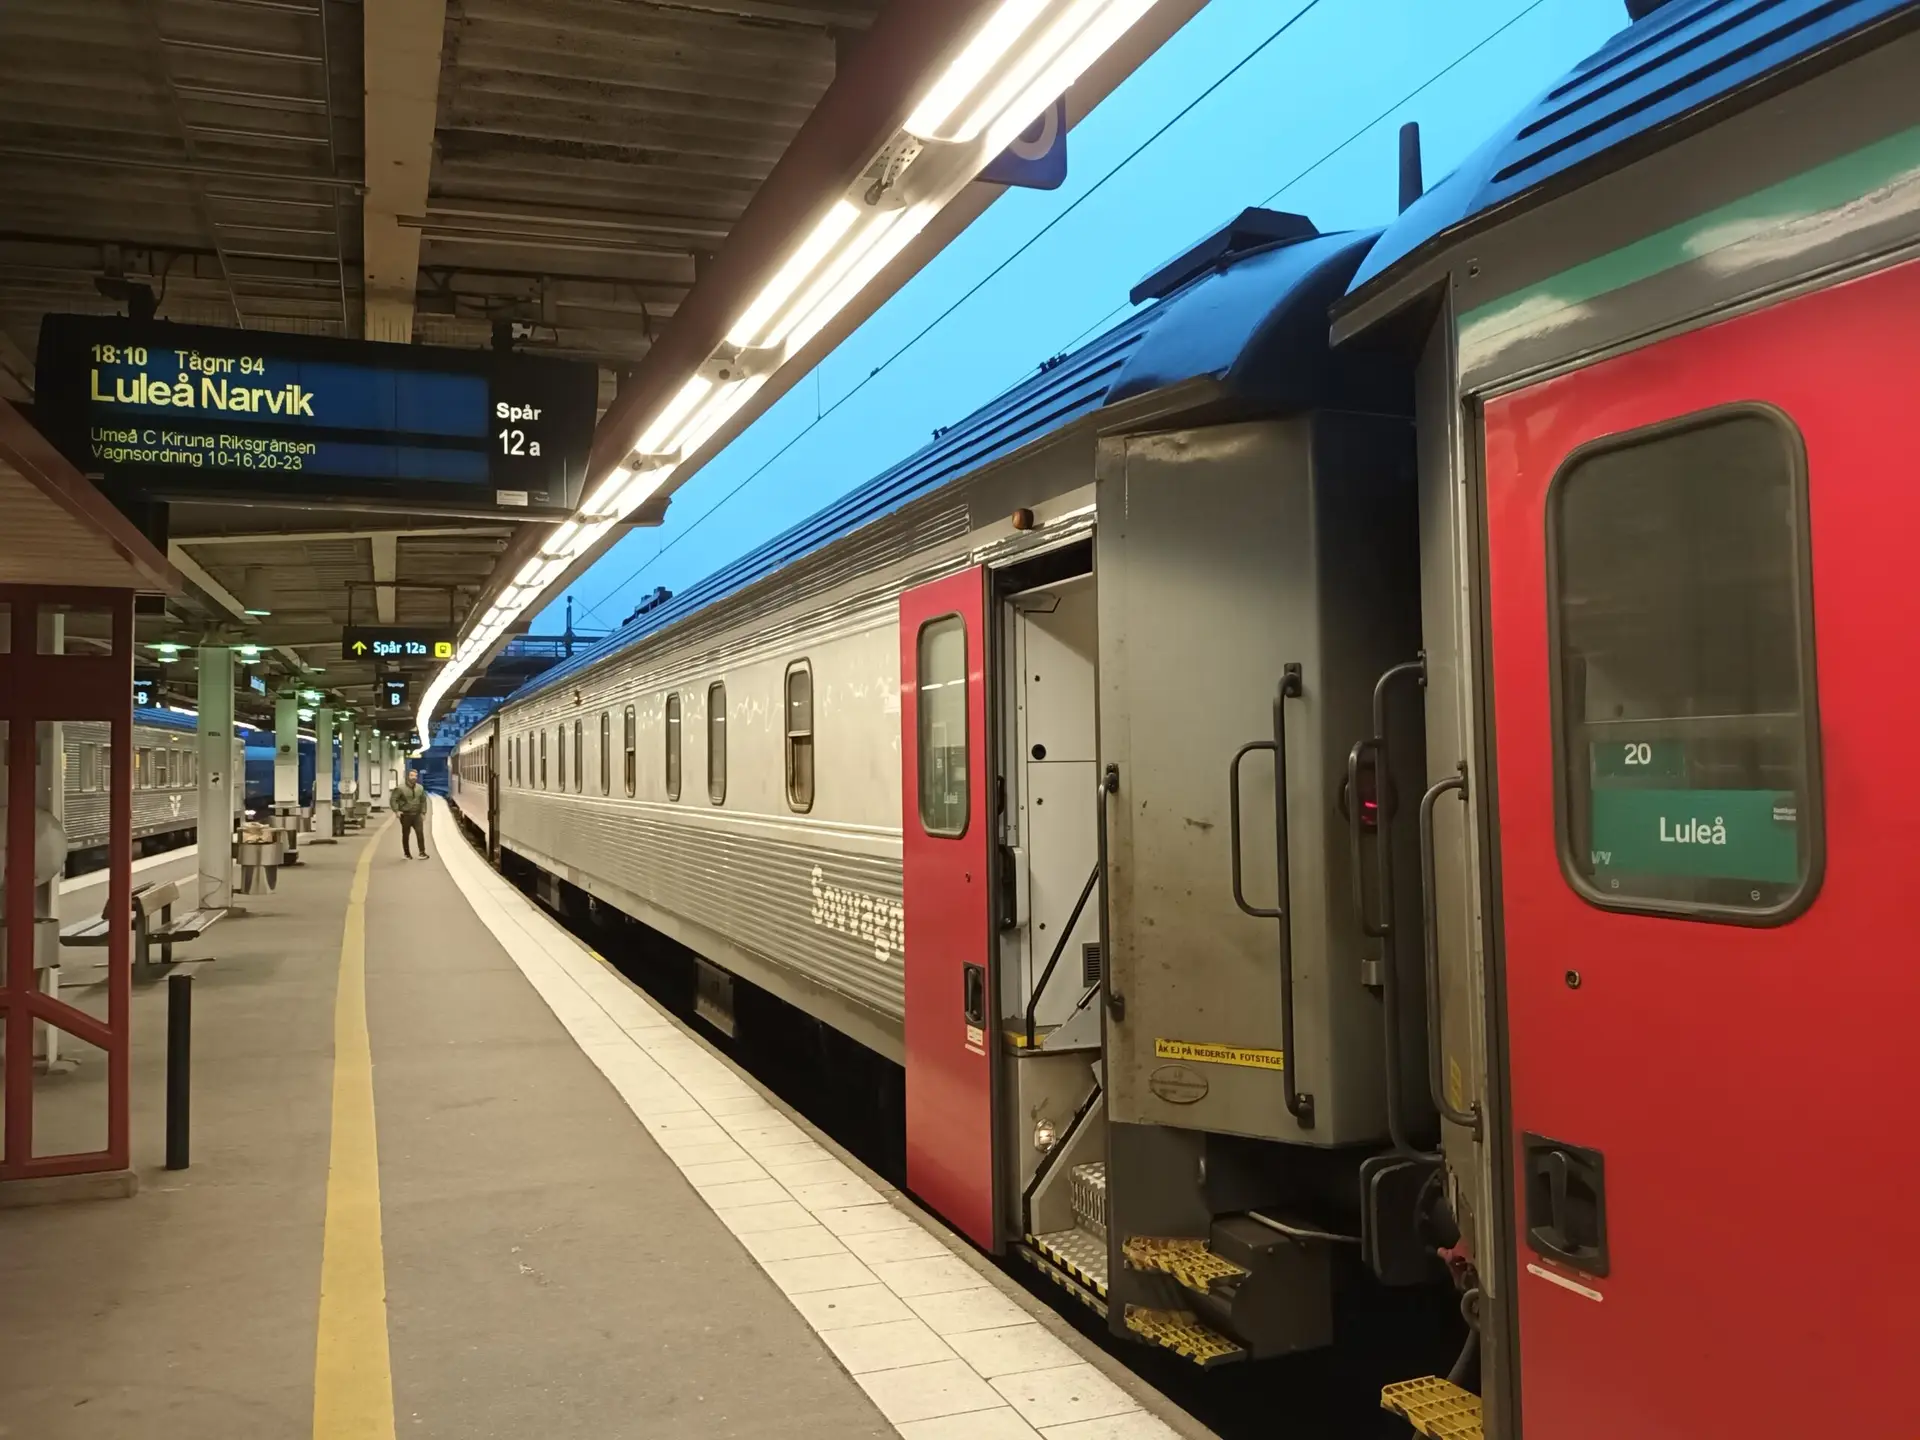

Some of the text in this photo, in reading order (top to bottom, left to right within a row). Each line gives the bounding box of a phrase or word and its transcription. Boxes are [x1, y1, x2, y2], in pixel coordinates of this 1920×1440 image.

[92, 344, 148, 366] 18:10
[174, 350, 265, 376] Tågnr 94
[91, 368, 315, 417] Luleå Narvik
[496, 402, 542, 423] Spår
[91, 427, 316, 455] Umeå C Kiruna Riksgränsen
[91, 443, 203, 468] Vagnsordning
[373, 641, 427, 656] Spår 12a
[138, 692, 148, 704] B
[391, 693, 400, 705] B
[1624, 743, 1651, 765] 20
[1659, 816, 1727, 845] Luleå
[1171, 1046, 1180, 1054] EJ
[1182, 1045, 1192, 1056] PÅ
[1195, 1048, 1236, 1060] NEDERSTA
